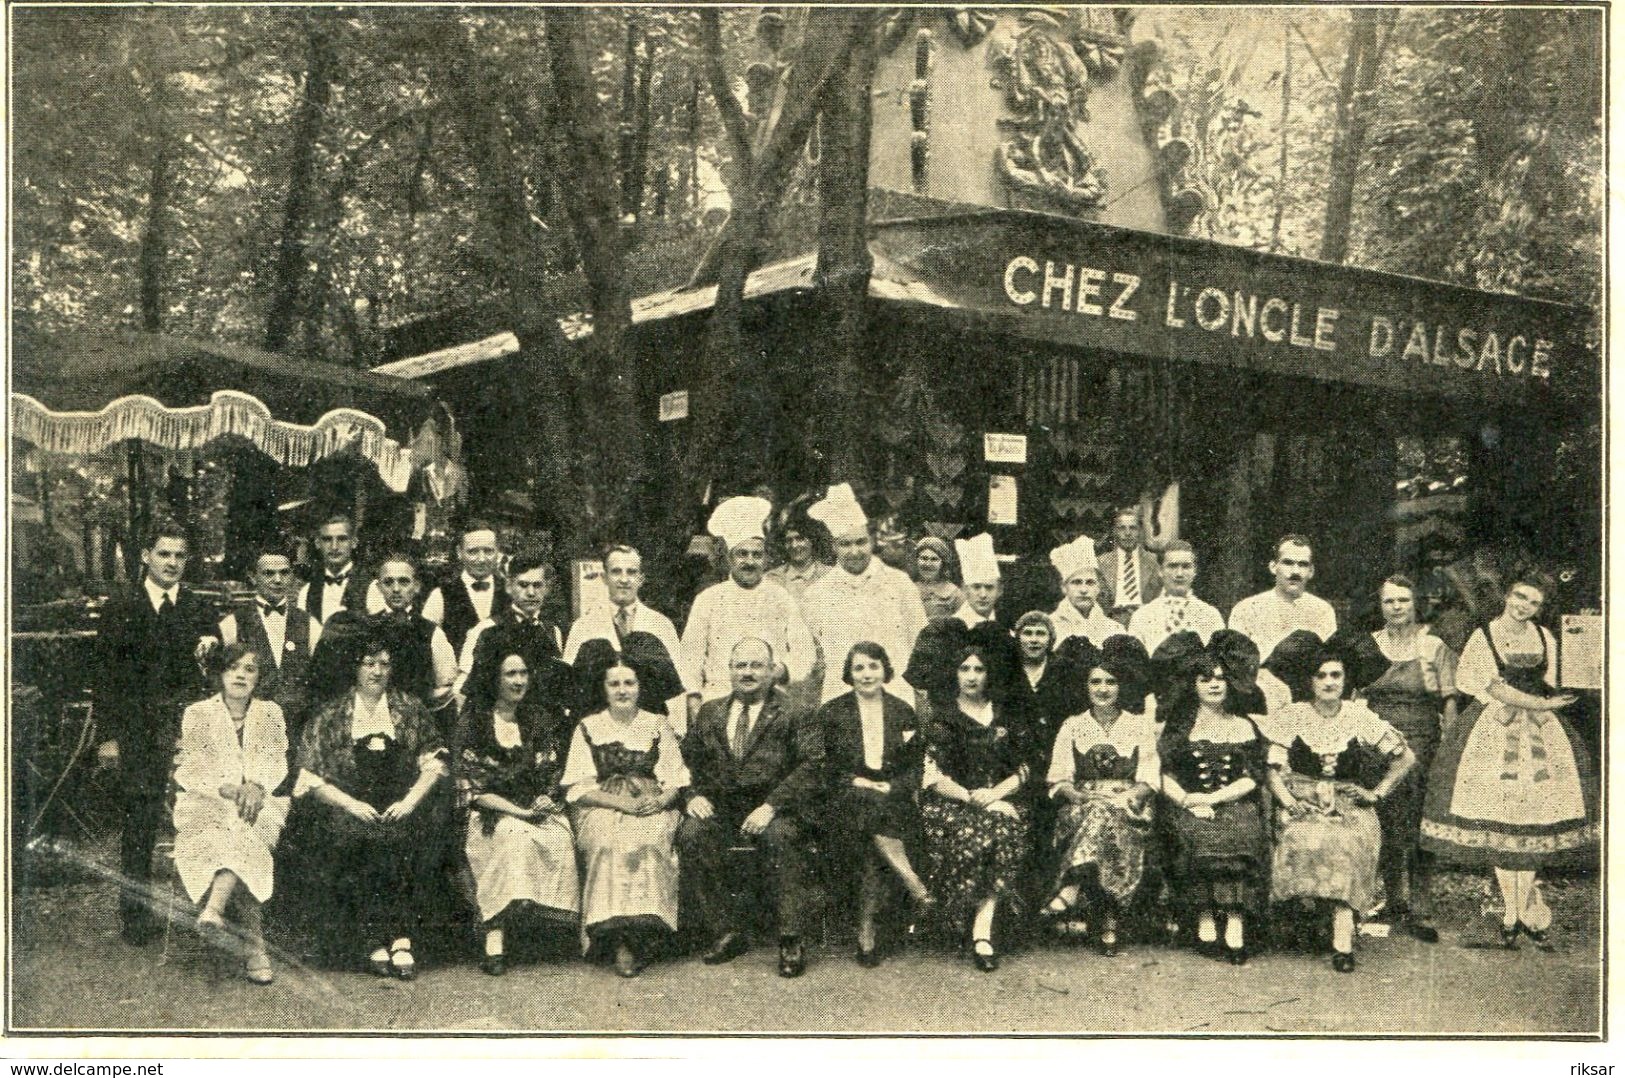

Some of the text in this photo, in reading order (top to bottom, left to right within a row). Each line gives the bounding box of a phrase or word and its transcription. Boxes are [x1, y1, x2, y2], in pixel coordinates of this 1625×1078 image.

[1003, 255, 1553, 378] CHEZ L'ONCLE D'ALSACE
